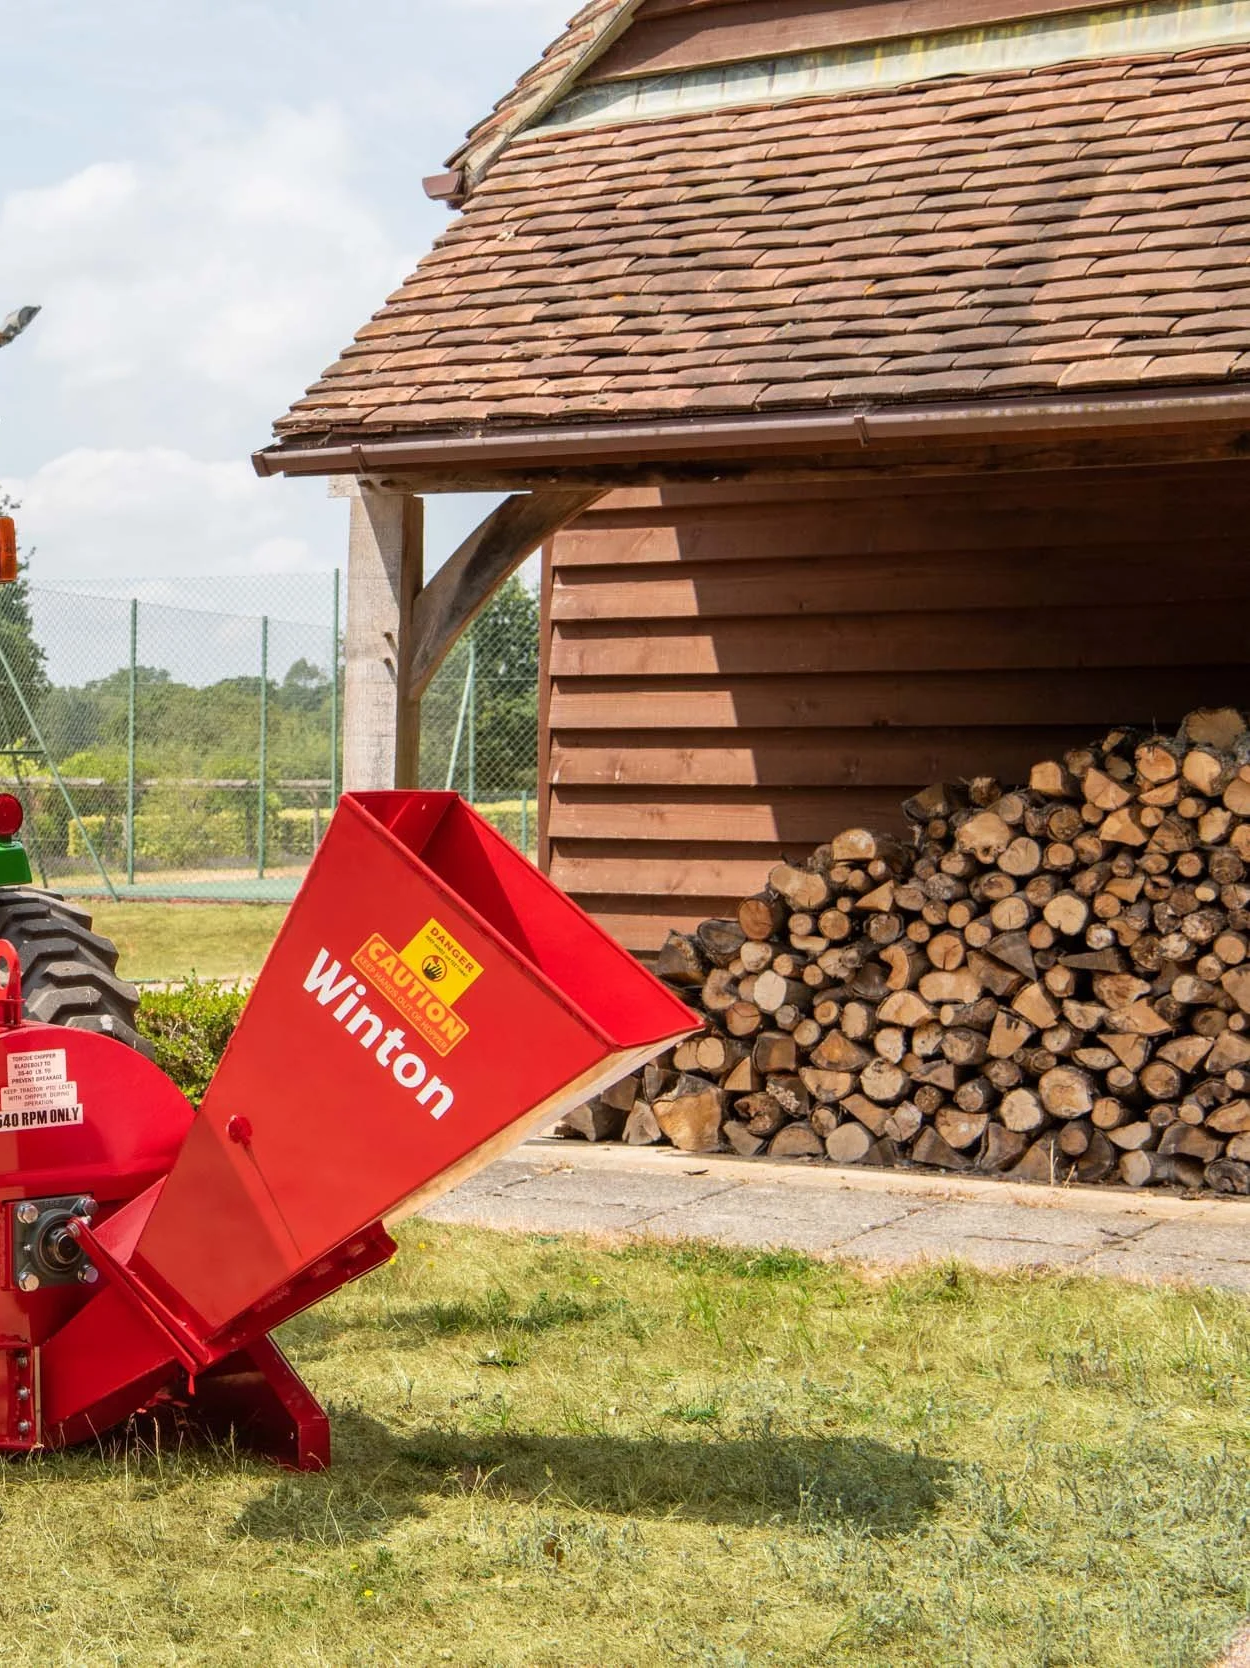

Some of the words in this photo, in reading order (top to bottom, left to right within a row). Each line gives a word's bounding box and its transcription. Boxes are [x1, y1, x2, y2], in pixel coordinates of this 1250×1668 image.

[430, 927, 475, 972] DANGER
[358, 955, 375, 973] KEEP
[374, 970, 398, 998] HANDS
[397, 996, 413, 1012] OUT
[411, 1011, 423, 1023] OF
[421, 1020, 448, 1049] HOPPER
[368, 942, 463, 1041] CAUTION
[302, 946, 454, 1120] Winton
[20, 1086, 44, 1094] TRACTOR
[35, 1074, 62, 1082] BREAKAGE
[22, 1110, 47, 1126] RPM
[50, 1107, 79, 1123] ONLY
[24, 1099, 54, 1107] OPERATION
